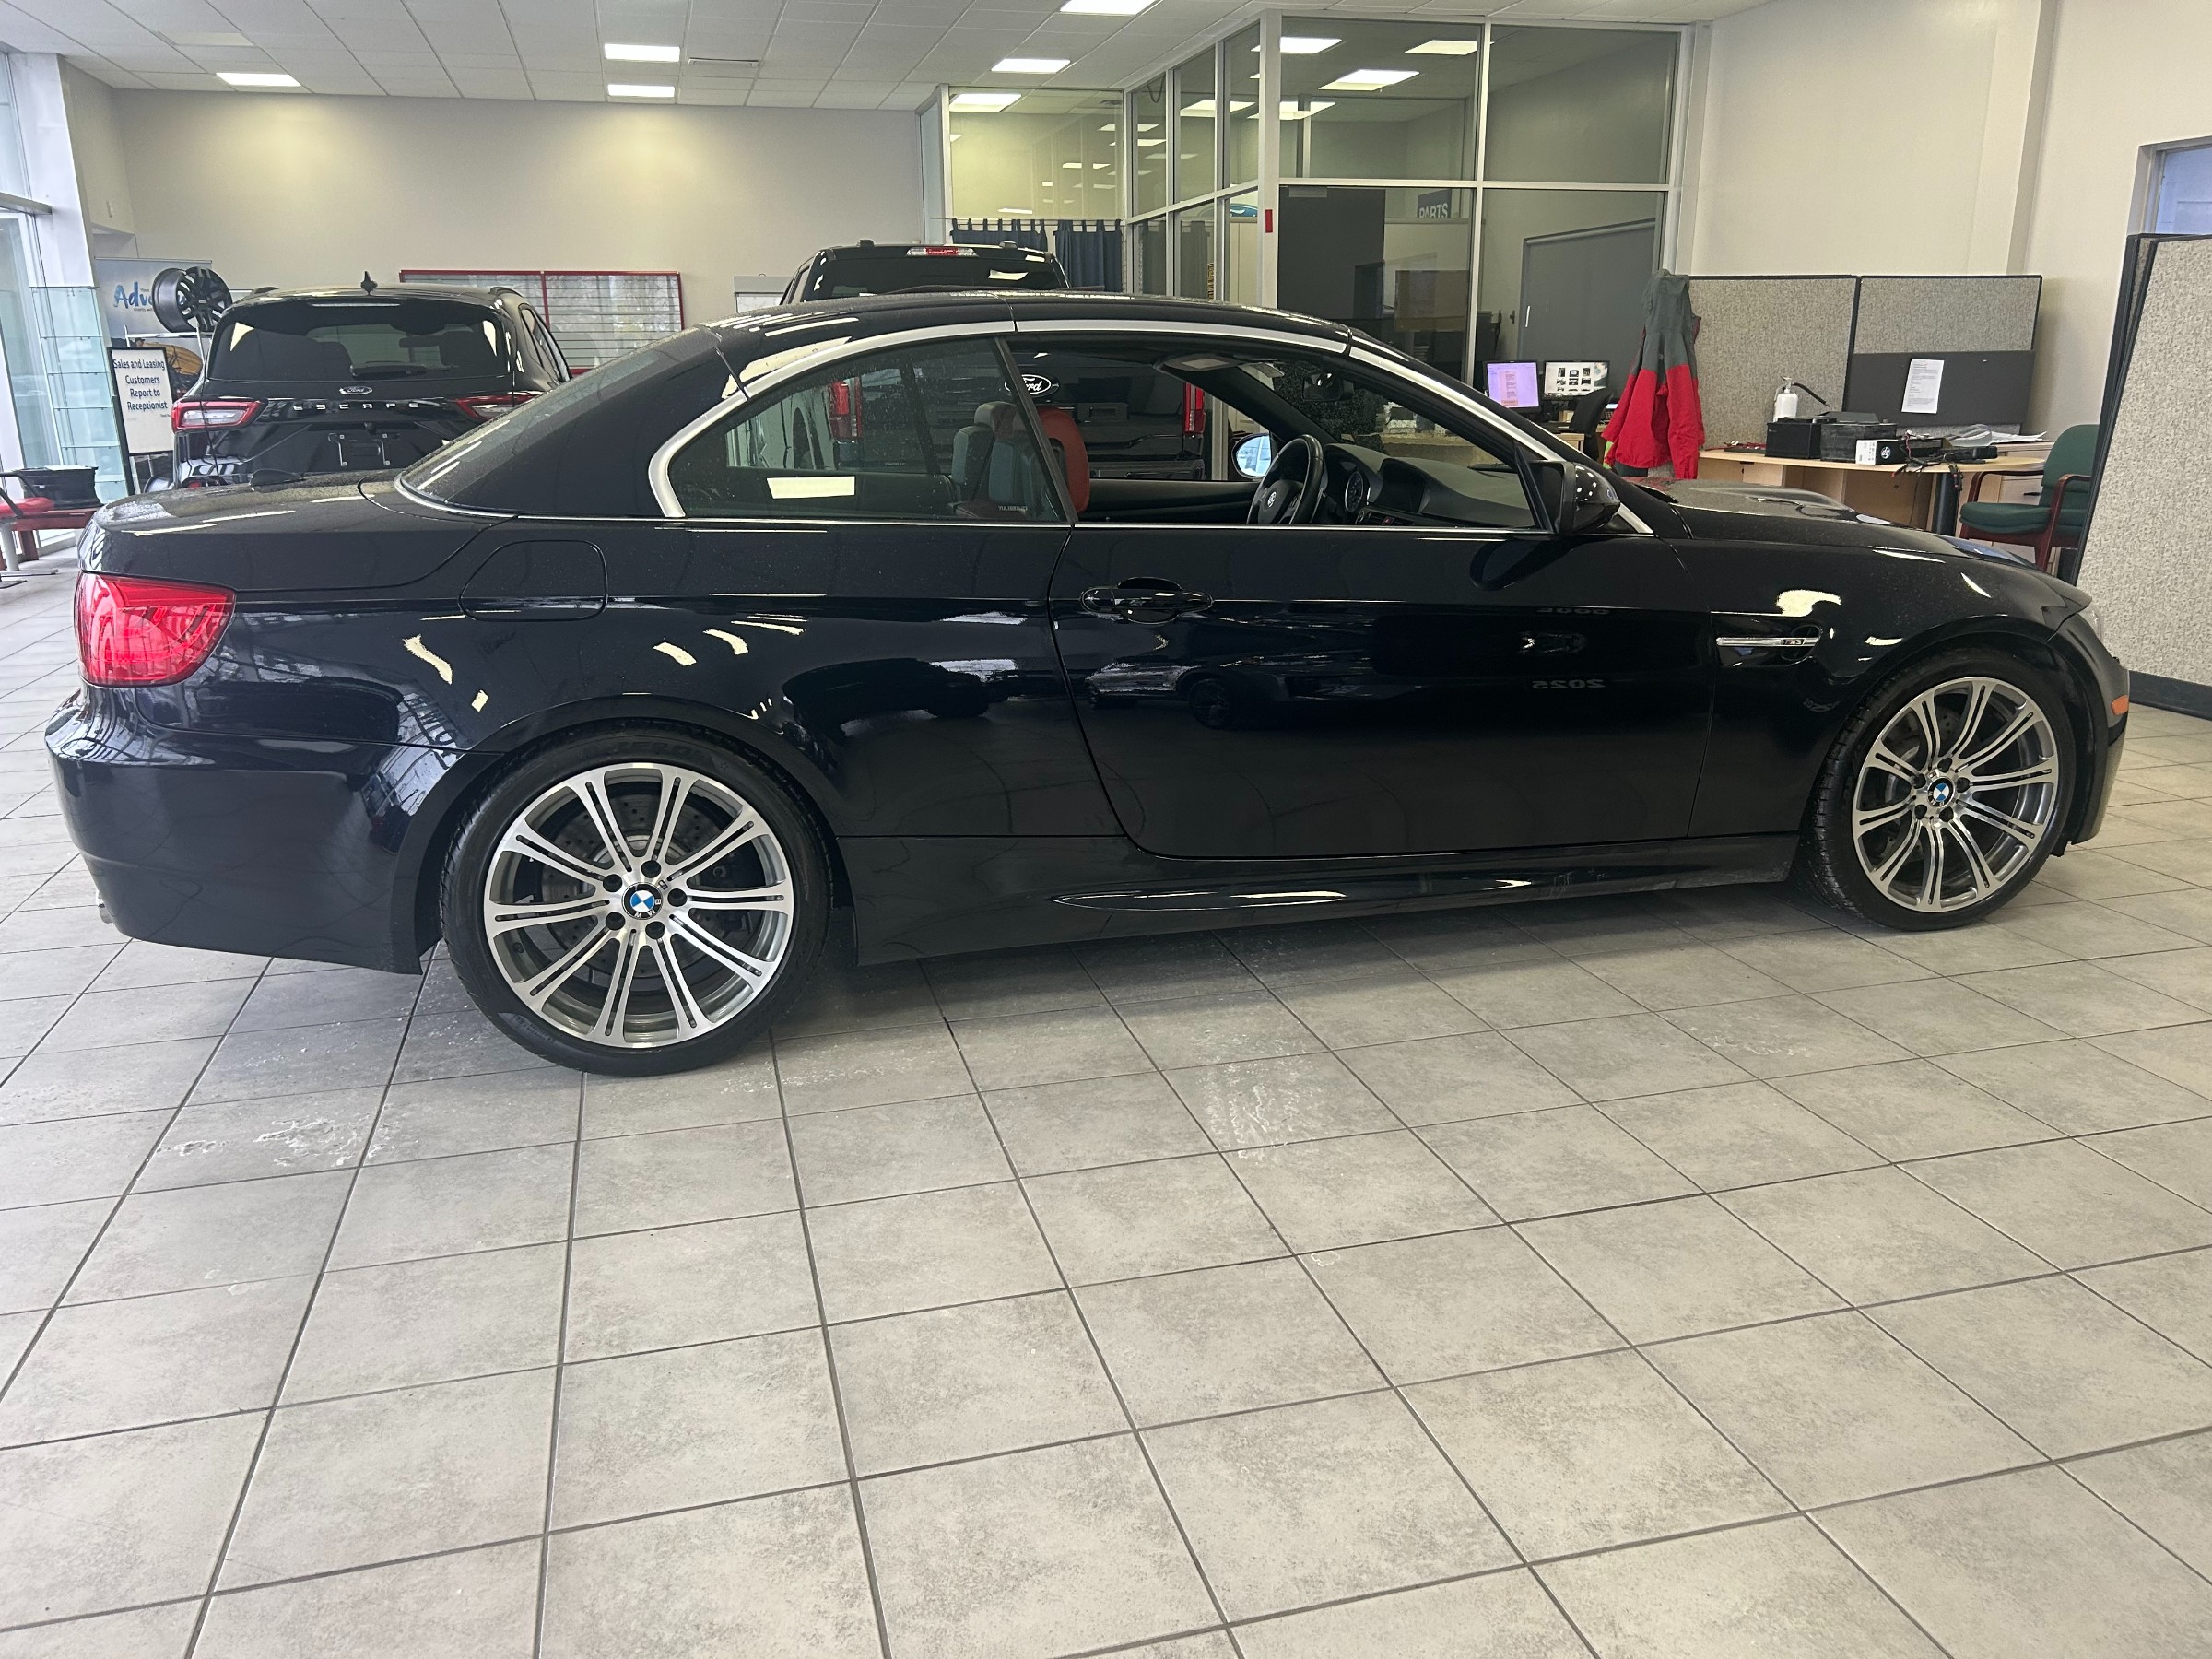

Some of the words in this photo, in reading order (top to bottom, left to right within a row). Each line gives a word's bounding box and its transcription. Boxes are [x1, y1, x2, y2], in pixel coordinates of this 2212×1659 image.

[1419, 202, 1449, 218] PARTS
[113, 359, 130, 369] Sales
[131, 359, 142, 369] and
[142, 359, 165, 371] Leasing
[125, 374, 160, 384] Customers
[130, 388, 152, 399] Report
[153, 388, 160, 397] to
[127, 401, 168, 412] Receptionist
[293, 402, 419, 411] ESCAPE
